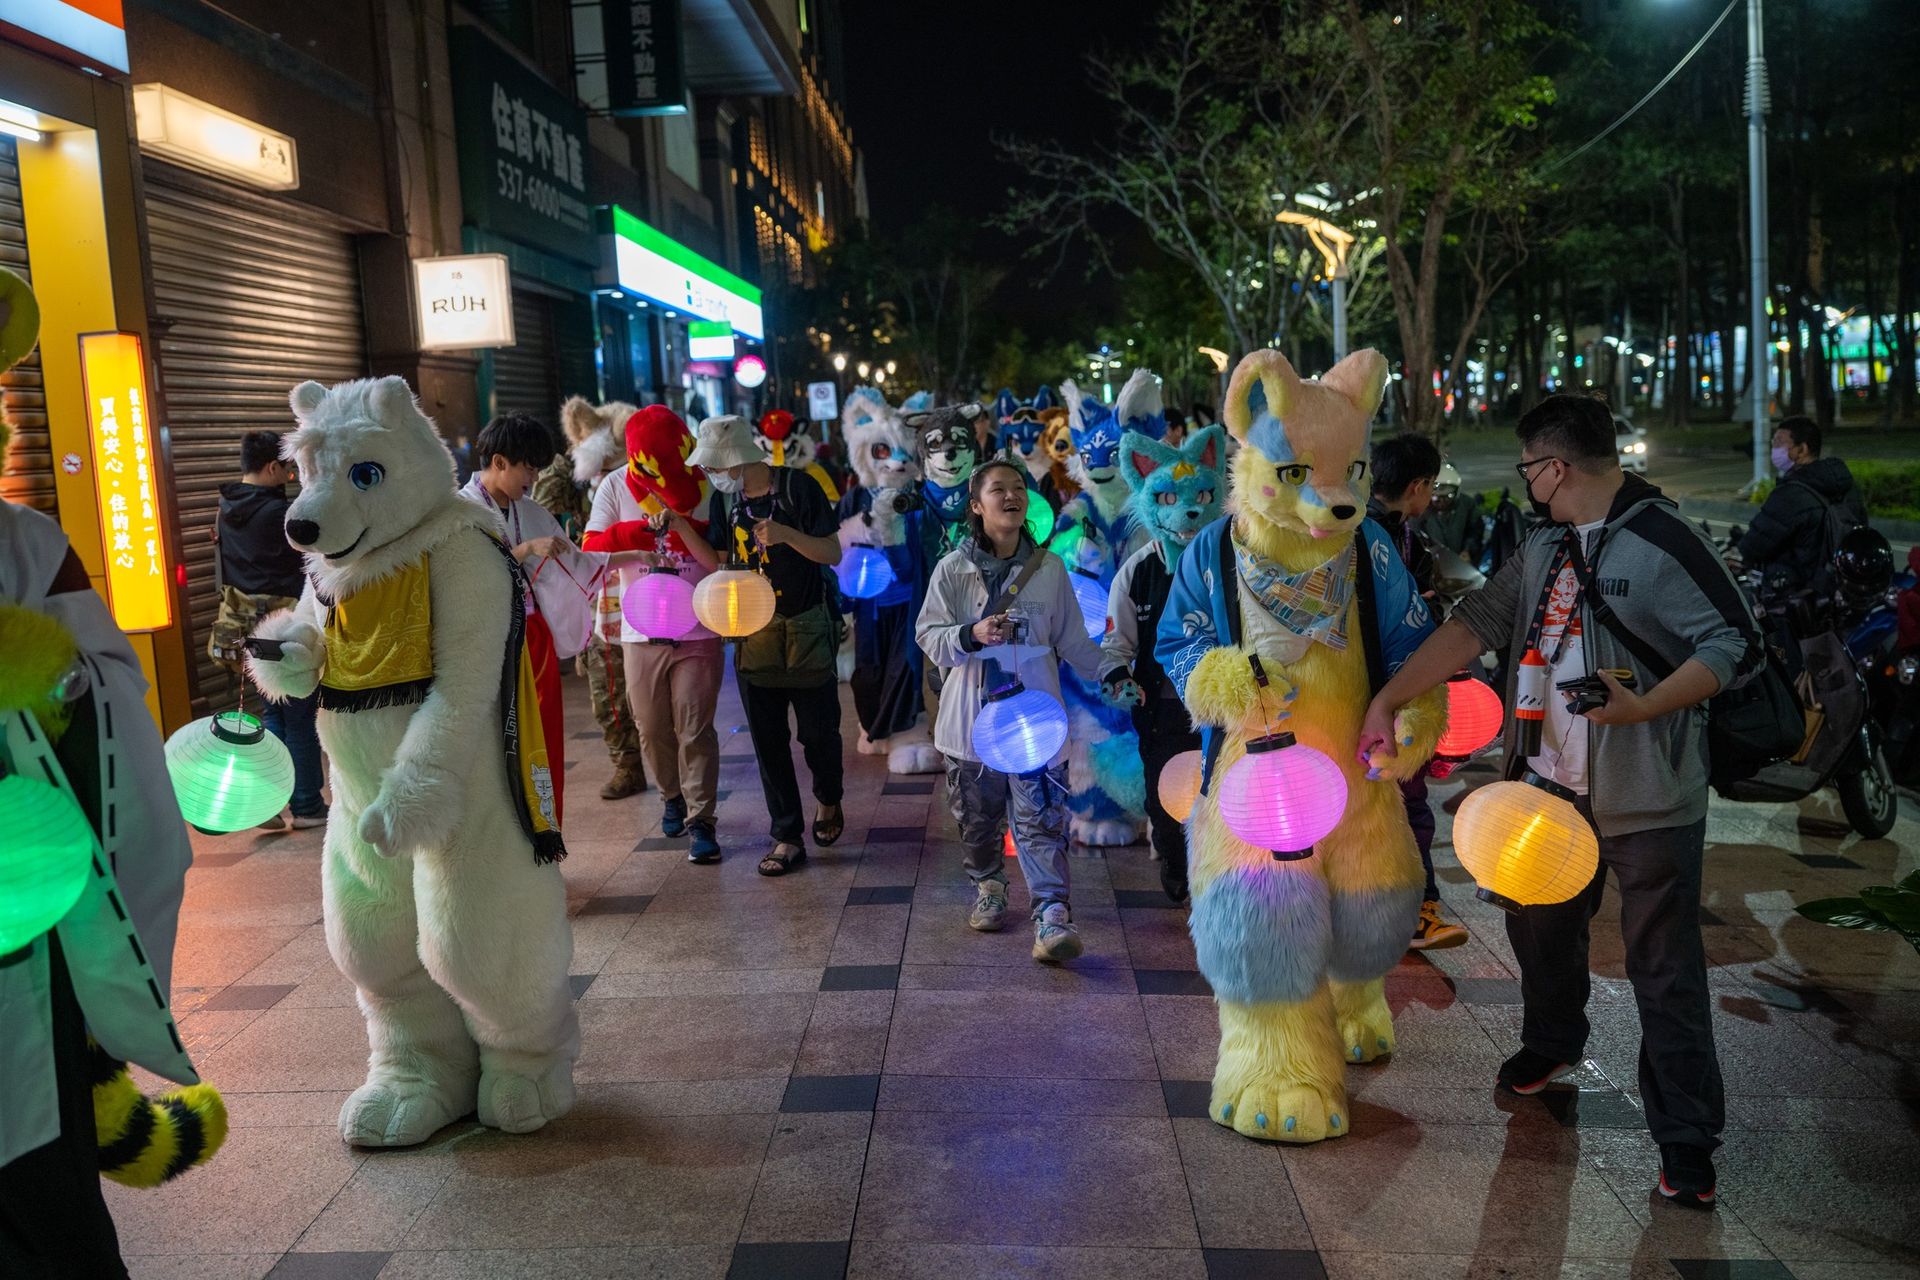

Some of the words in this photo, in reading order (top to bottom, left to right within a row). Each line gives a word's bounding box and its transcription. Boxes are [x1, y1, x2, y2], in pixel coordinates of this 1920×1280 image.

[630, 0, 657, 98] 商不動產
[492, 82, 585, 192] 住商不動產
[497, 159, 560, 221] 537-6000
[432, 295, 487, 314] RUH
